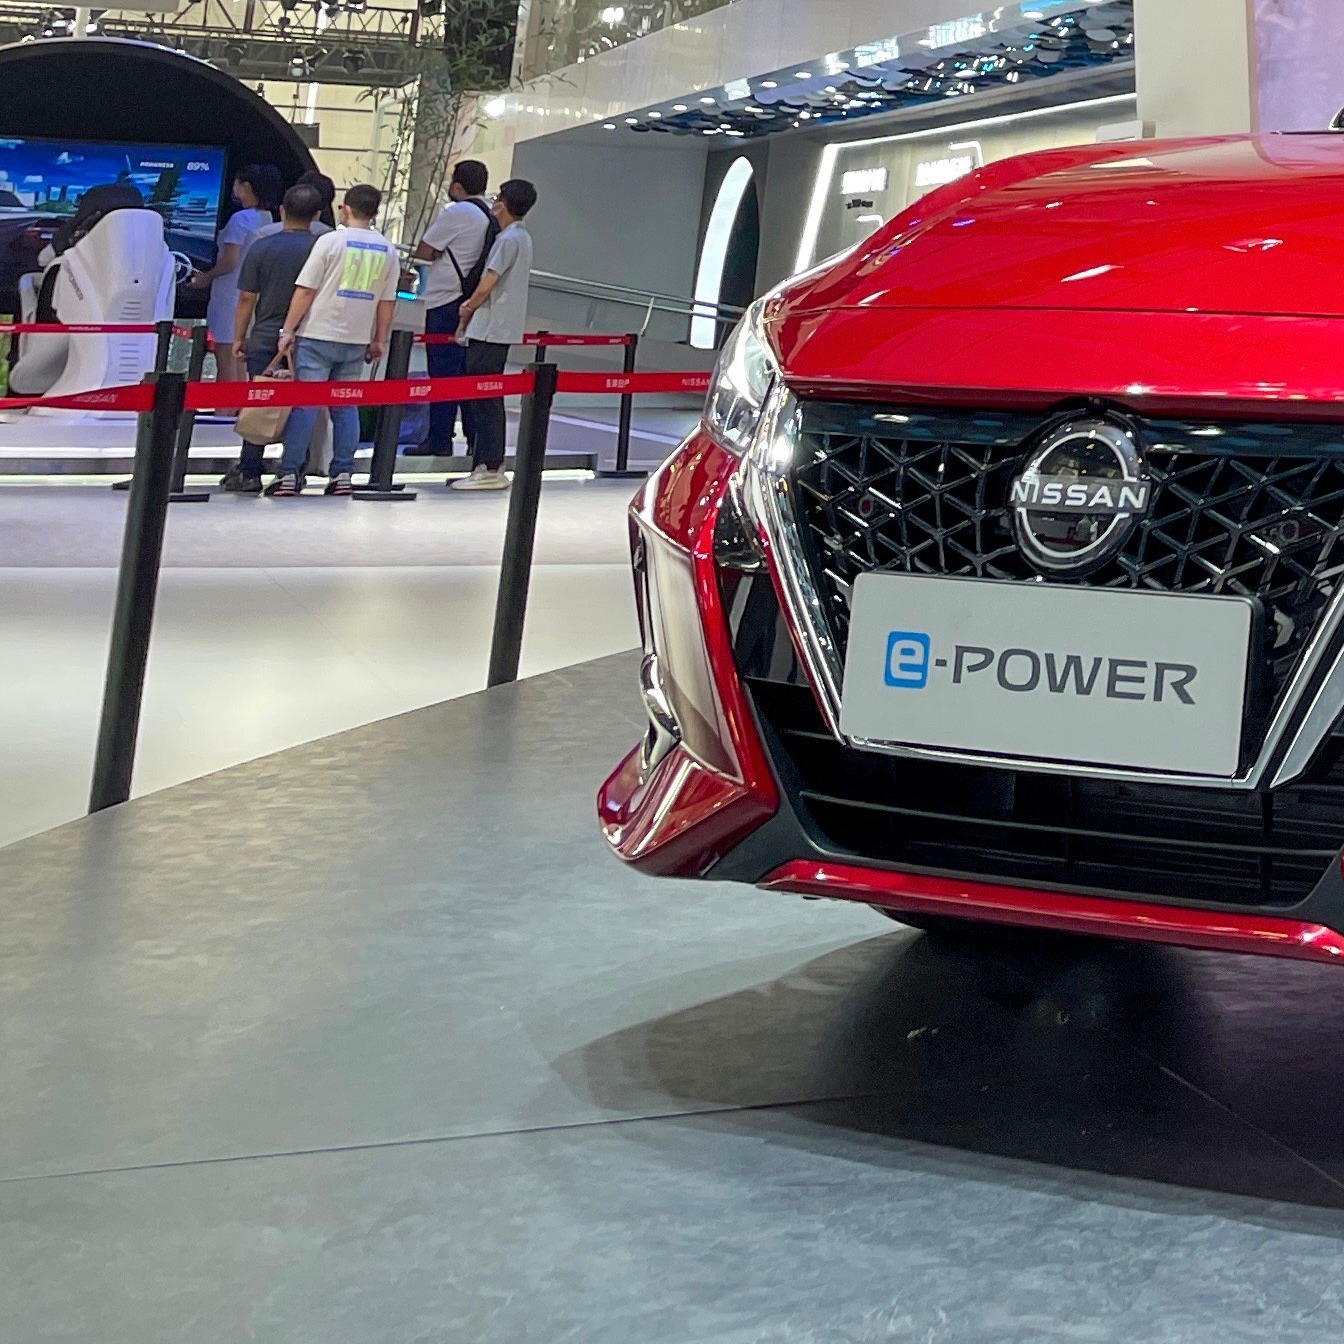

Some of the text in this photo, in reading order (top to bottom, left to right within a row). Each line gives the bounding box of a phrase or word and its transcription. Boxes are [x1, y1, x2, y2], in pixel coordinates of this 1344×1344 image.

[330, 387, 364, 399] NISSAN
[1009, 480, 1147, 509] NISSAN
[883, 630, 1198, 706] e-POWER
